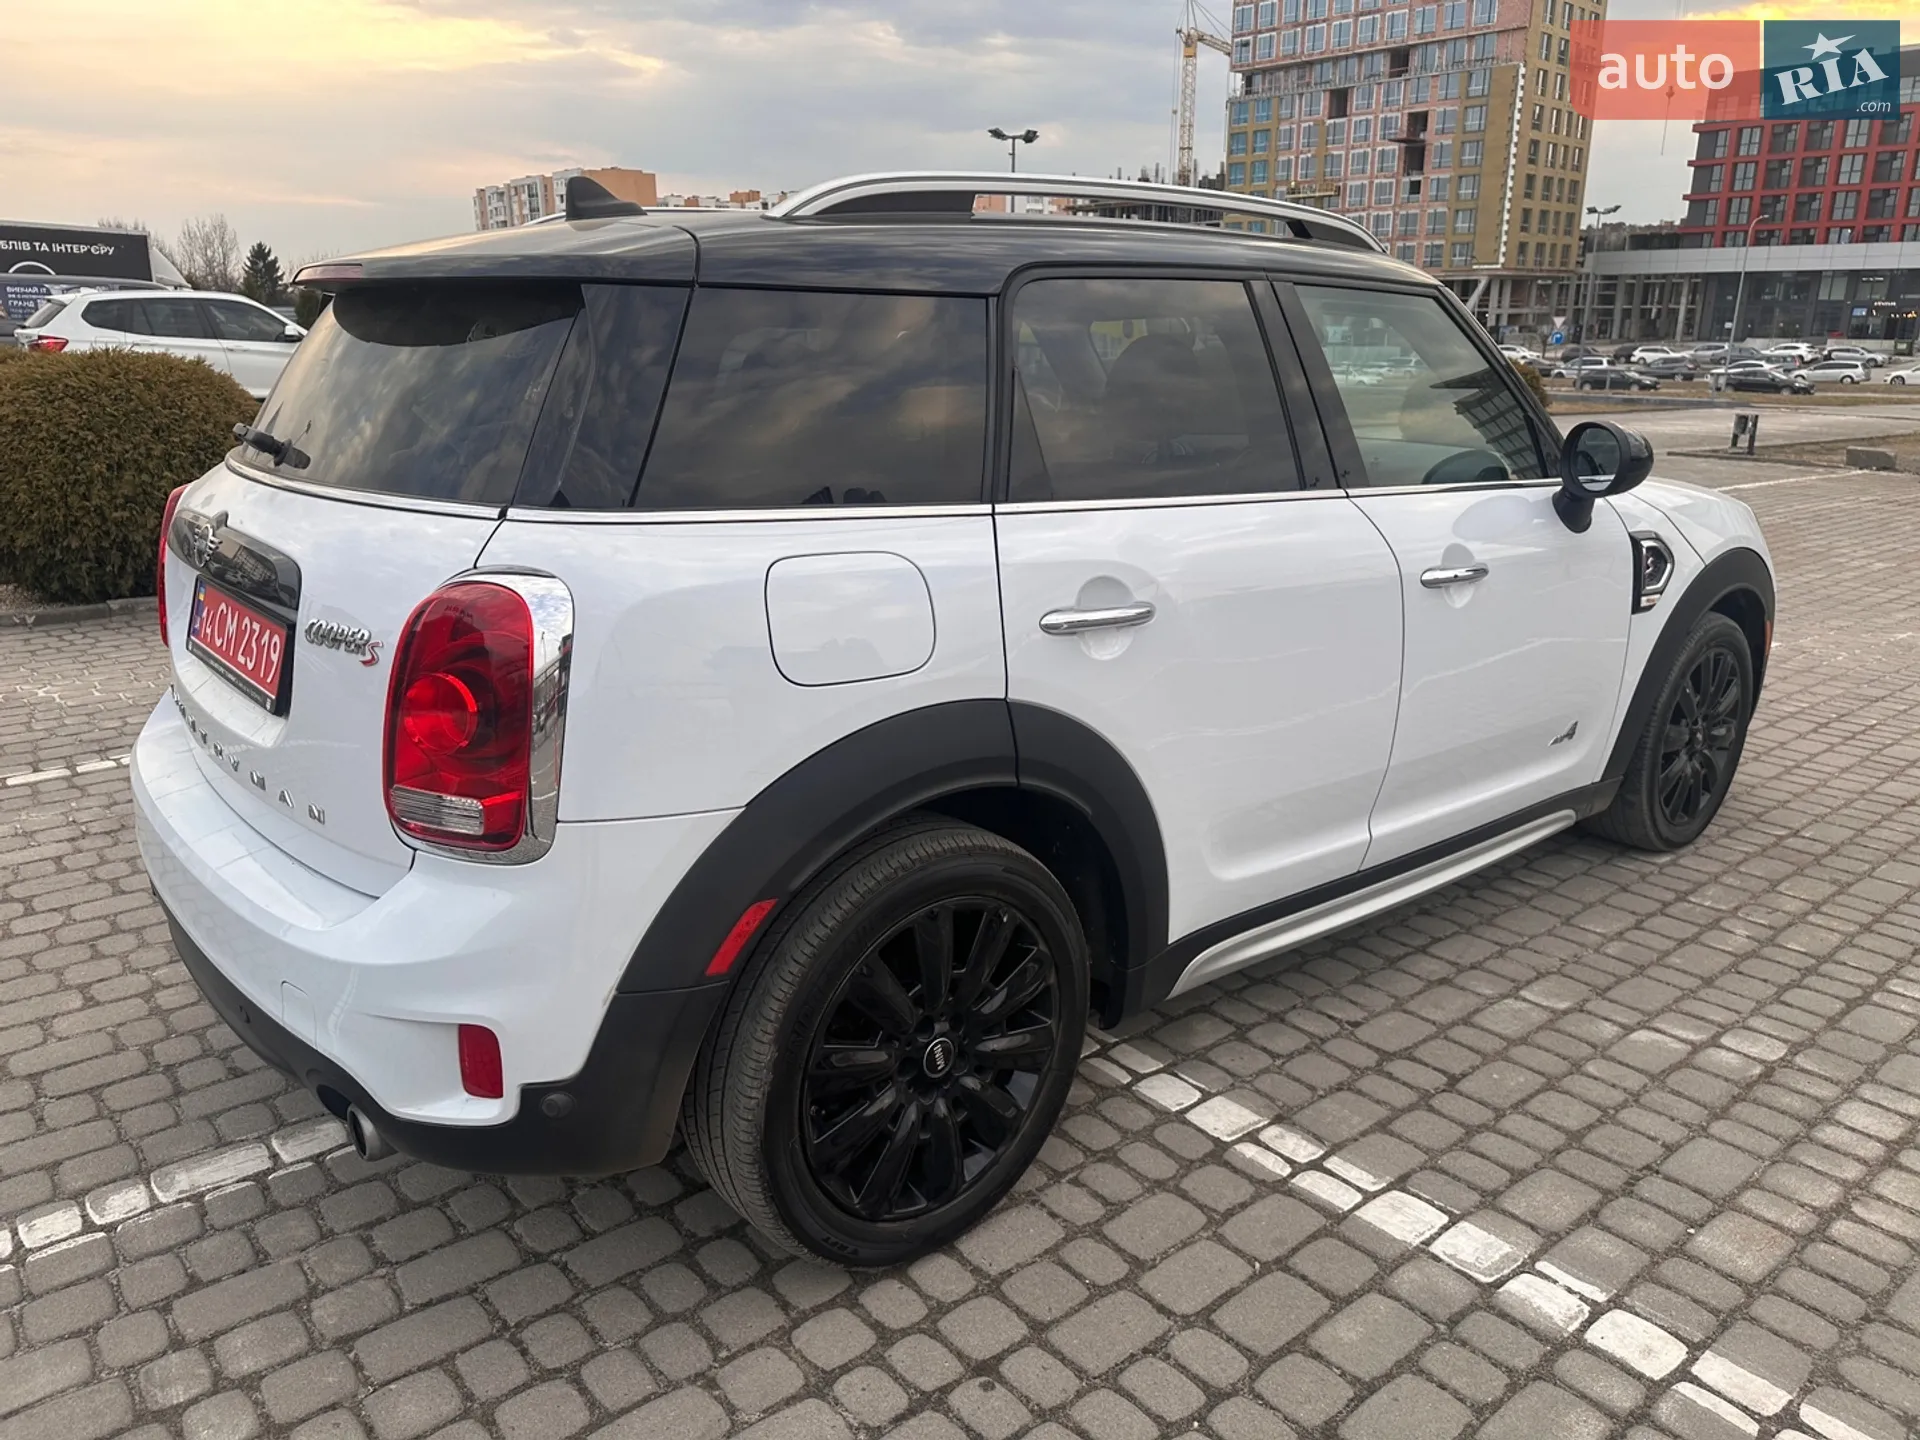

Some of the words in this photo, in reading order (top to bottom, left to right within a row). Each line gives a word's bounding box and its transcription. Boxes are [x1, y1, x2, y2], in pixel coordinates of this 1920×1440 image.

[33, 241, 50, 252] ТА
[170, 683, 326, 825] UNTRYMAN
[933, 1044, 946, 1070] MINI
